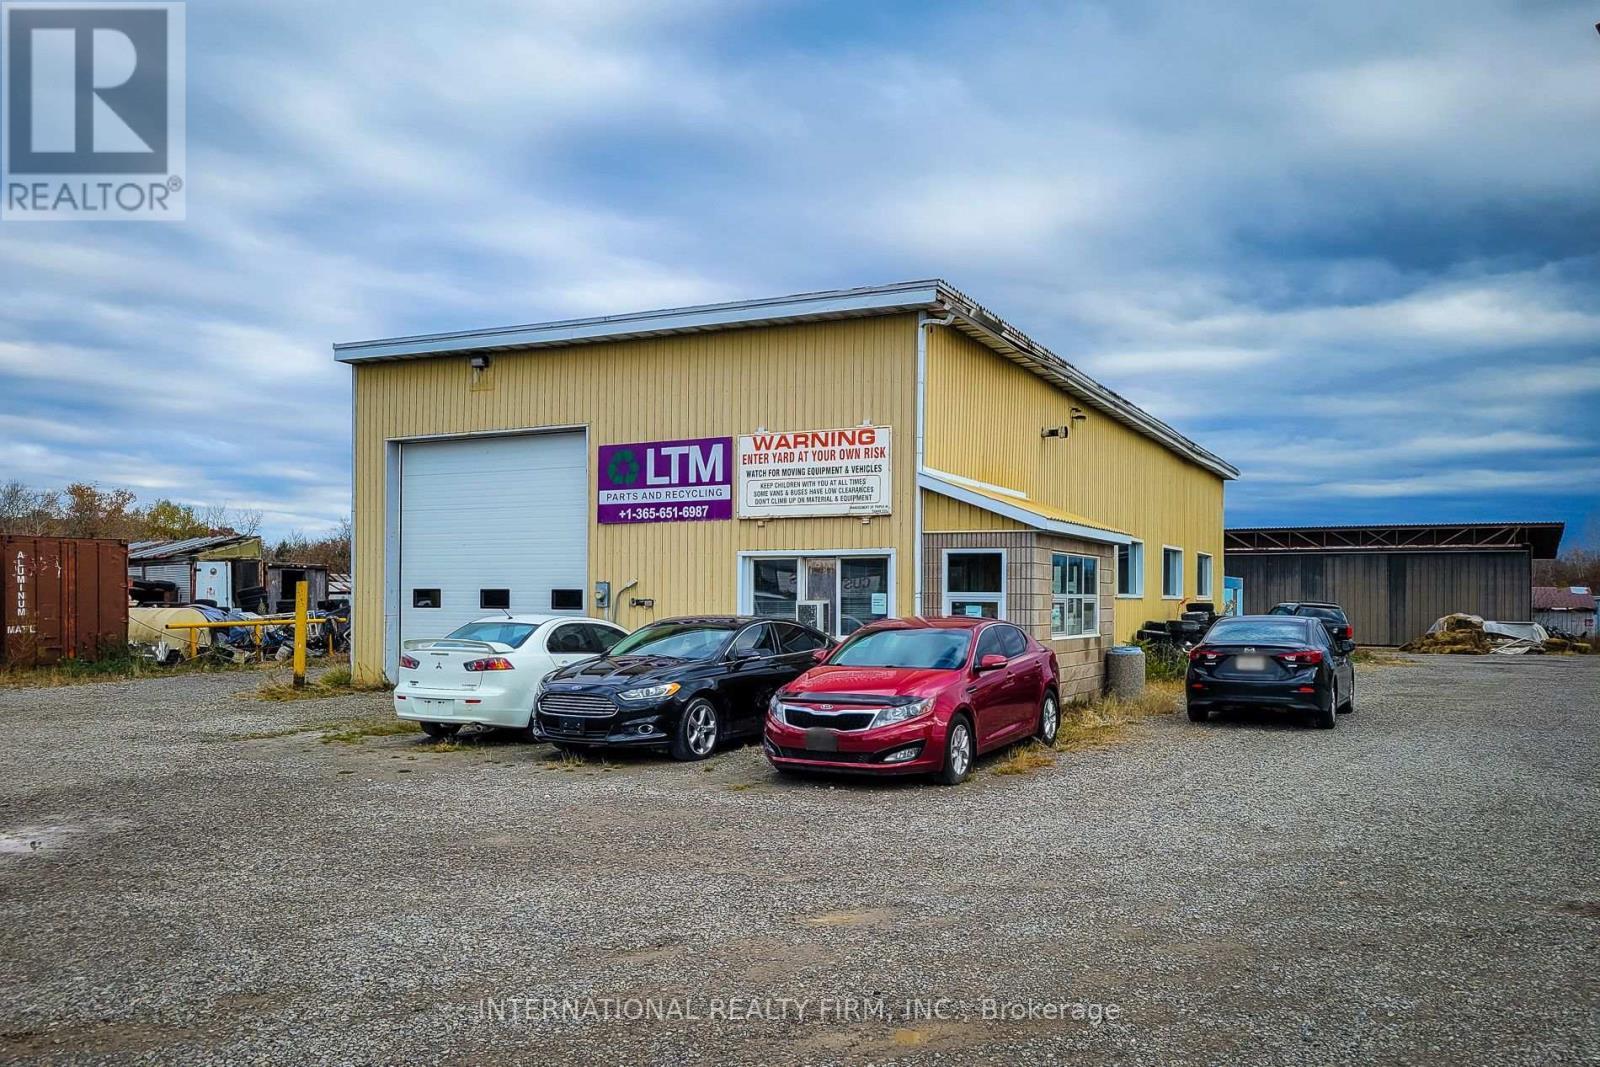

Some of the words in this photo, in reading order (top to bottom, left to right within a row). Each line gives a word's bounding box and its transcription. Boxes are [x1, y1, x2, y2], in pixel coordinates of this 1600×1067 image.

[753, 428, 875, 452] WARNING
[742, 453, 769, 465] ENTER
[772, 451, 795, 464] YARD
[798, 450, 809, 462] AT
[812, 449, 836, 462] YOUR
[840, 447, 861, 460] OWN
[864, 446, 886, 459] RISK
[646, 443, 723, 485] LTM
[746, 469, 766, 478] WATCH
[768, 468, 780, 477] FOR
[782, 467, 806, 477] MOVING
[807, 466, 843, 476] EQUIPMENT
[845, 465, 850, 474] &
[851, 464, 882, 473] VEHICLES
[775, 481, 801, 489] CHILDREN
[802, 480, 816, 488] WITH
[817, 479, 829, 487] YOU
[829, 479, 837, 487] AT
[606, 492, 638, 501] PARTS
[641, 491, 662, 500] AND
[665, 488, 723, 499] RECYCLING
[754, 490, 768, 498] SOME
[769, 489, 783, 497] VANS
[790, 488, 808, 496] BUSES
[824, 487, 837, 495] LOW
[838, 486, 874, 494] CLEARANCES
[771, 497, 787, 505] CLIMB
[806, 495, 833, 503] MATERIAL
[840, 494, 872, 503] EQUIPMENT
[619, 505, 709, 519] +1-365-651-6987
[17, 551, 26, 616] ALUMINUM
